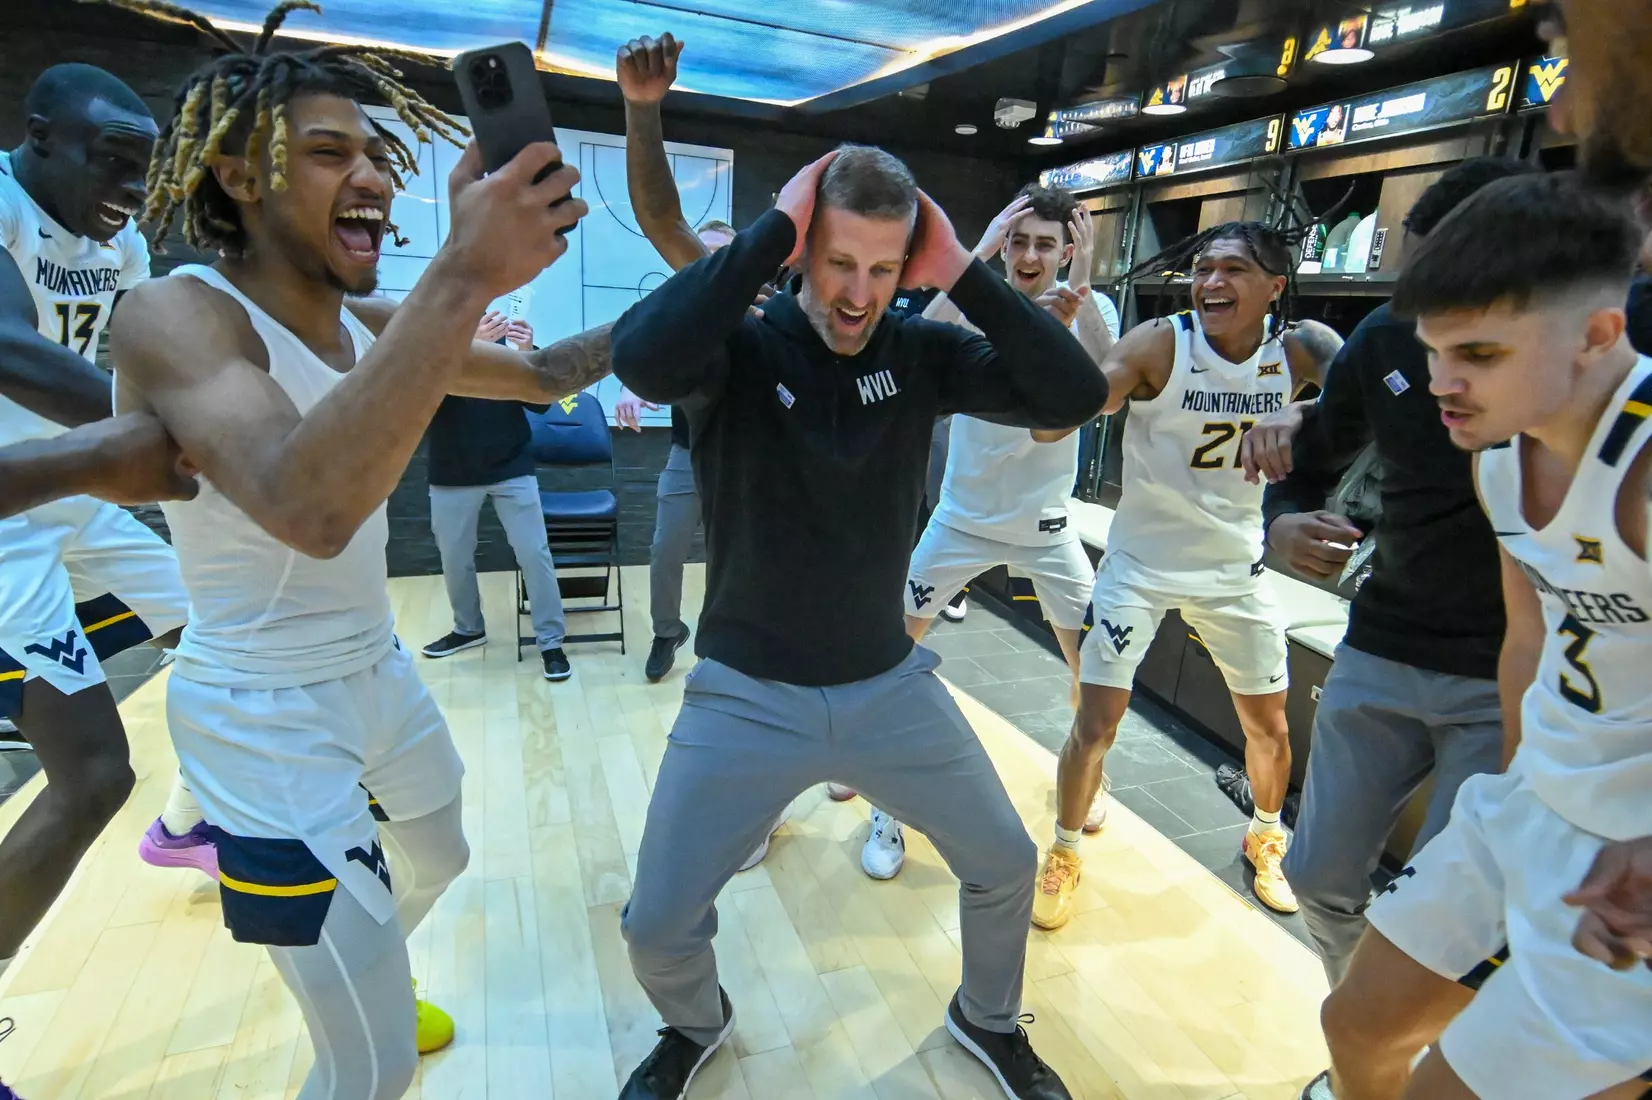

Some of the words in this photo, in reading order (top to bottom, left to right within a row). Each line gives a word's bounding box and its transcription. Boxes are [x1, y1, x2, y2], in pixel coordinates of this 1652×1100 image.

[1486, 66, 1512, 111] 2
[1264, 118, 1280, 152] 9
[856, 369, 897, 405] WVU
[1181, 389, 1283, 415] MOUNTAINEERS
[1557, 612, 1604, 714] 3
